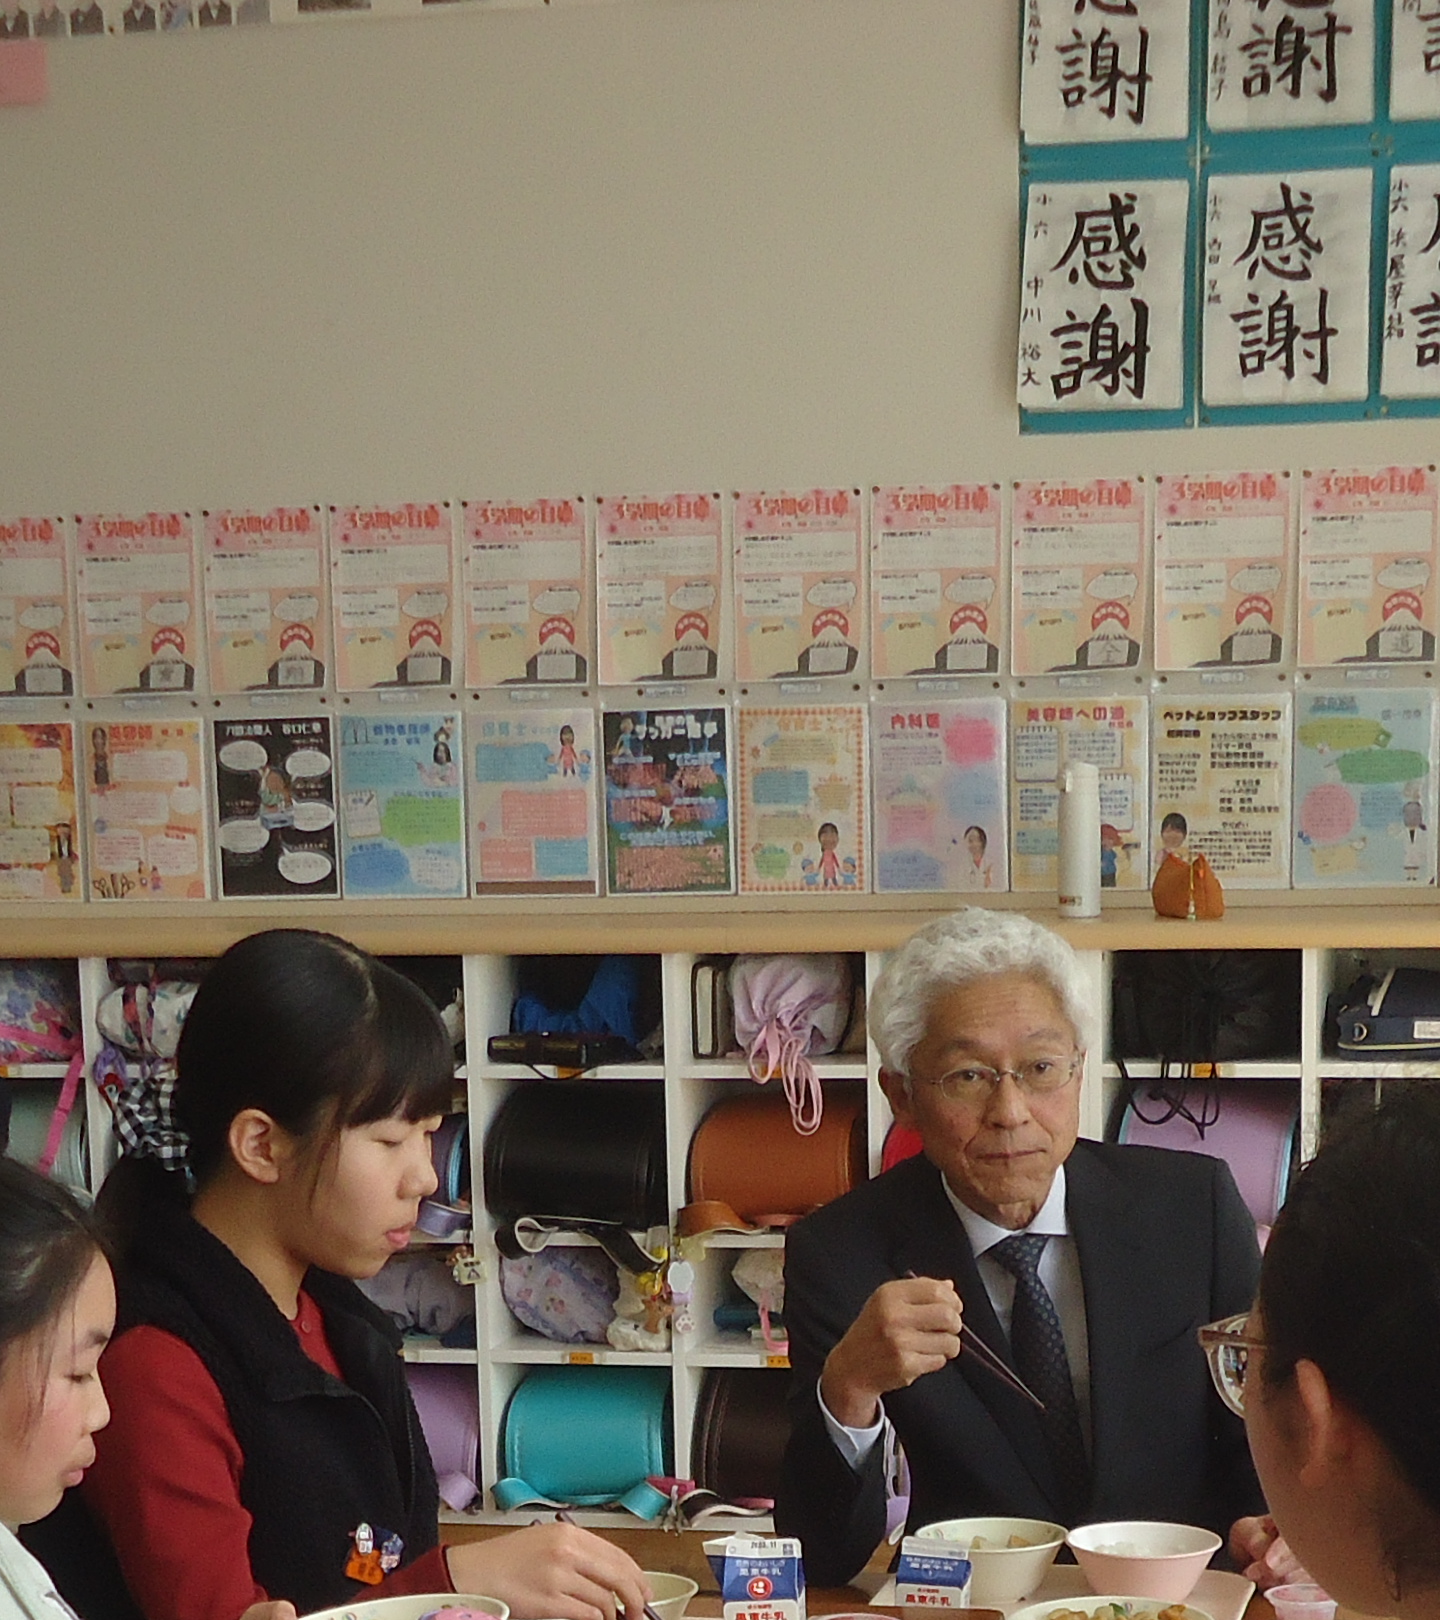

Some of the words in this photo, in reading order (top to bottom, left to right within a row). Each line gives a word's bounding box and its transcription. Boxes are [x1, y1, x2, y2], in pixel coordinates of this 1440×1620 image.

[1033, 193, 1052, 240] 小六
[1230, 182, 1338, 385] 感謝
[1050, 192, 1150, 400] 感謝
[1172, 480, 1277, 503] 3学期の目標
[1318, 474, 1426, 496] 3学期の目標
[1028, 486, 1132, 508] 3学期の目標
[890, 713, 942, 730] 内科医
[1025, 706, 1127, 722] 美容師への道
[1163, 709, 1282, 721] ペットショップスタッフ
[905, 1593, 951, 1606] 黒東牛乳
